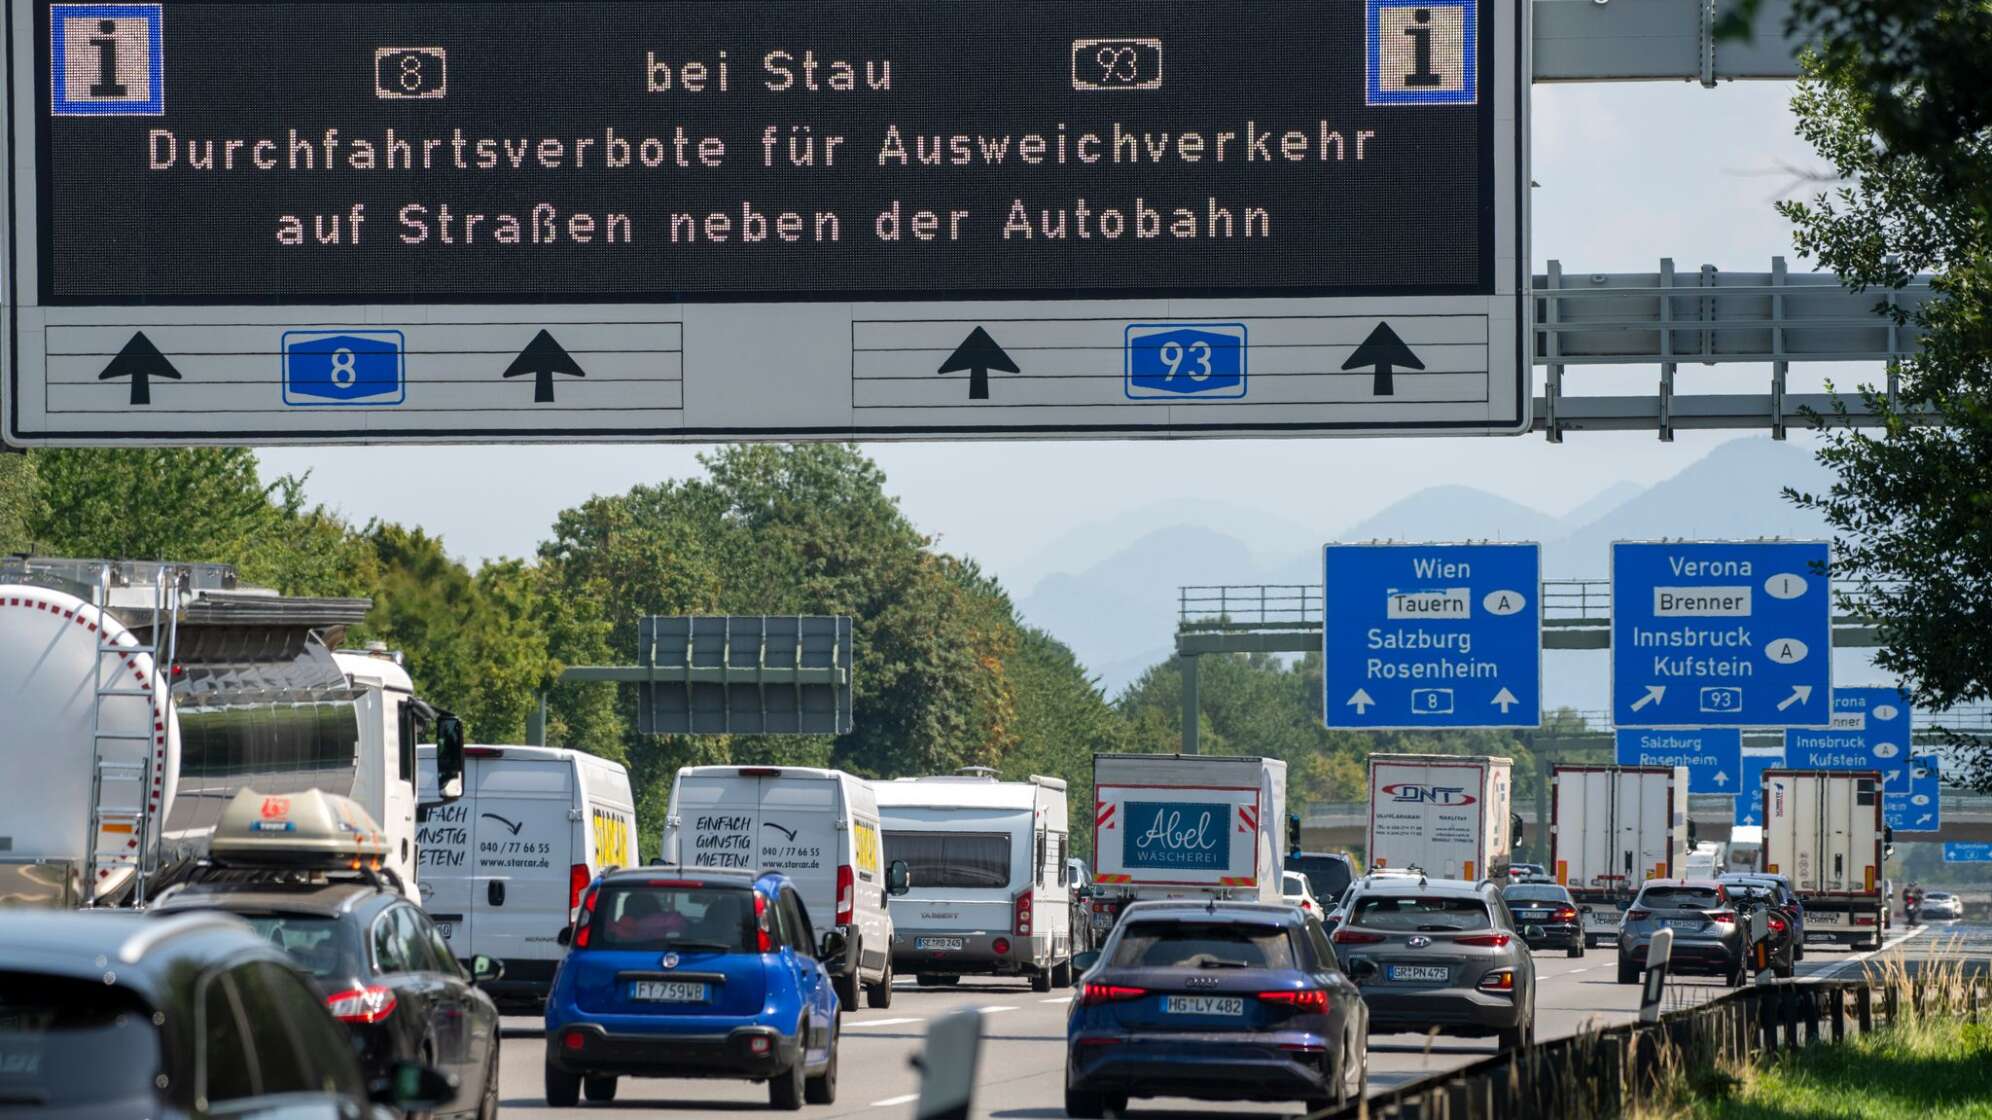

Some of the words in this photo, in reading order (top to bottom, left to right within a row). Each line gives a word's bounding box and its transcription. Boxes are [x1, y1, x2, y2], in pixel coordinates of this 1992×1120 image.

[400, 54, 421, 90] 8
[647, 52, 728, 93] bei
[763, 50, 892, 91] Stau
[1097, 46, 1138, 83] 93
[148, 128, 726, 170] Durchfahrtsverbote
[762, 125, 844, 167] für
[878, 121, 1376, 165] Ausweichverkehr
[276, 203, 364, 245] auf
[398, 202, 633, 245] Straßen
[670, 201, 840, 244] neben
[875, 199, 969, 241] der
[1003, 197, 1271, 240] Autobahn
[330, 348, 356, 389] 8
[1159, 341, 1213, 383] 93
[1413, 558, 1470, 579] Wien
[1669, 556, 1752, 576] Verona
[1394, 595, 1463, 612] Tauern
[1497, 596, 1511, 610] A
[1660, 593, 1744, 610] Brenner
[1367, 628, 1471, 653] Salzburg
[1633, 626, 1752, 647] Innsbruck
[1780, 643, 1793, 658] A
[1367, 658, 1498, 679] Rosenheim
[1654, 656, 1752, 676] Kufstein
[1428, 693, 1438, 708] 8
[1711, 692, 1731, 707] 93
[1834, 696, 1866, 707] rona
[1833, 717, 1861, 727] nner
[1640, 735, 1702, 751] Salzburg
[1796, 735, 1866, 748] Innsbruck
[1640, 753, 1717, 767] Rosenheim
[1809, 753, 1867, 767] Kufstein
[1136, 808, 1217, 849] Abel
[480, 841, 499, 853] 040
[508, 842, 521, 853] 77
[523, 842, 535, 853] 66
[538, 842, 550, 853] 55
[762, 847, 777, 857] 040
[785, 847, 795, 857] 77
[418, 851, 465, 867] ETEN!
[480, 857, 549, 869] www.starcar.de
[762, 859, 820, 869] www.starcar.de
[1168, 995, 1187, 1012] HG
[1195, 996, 1213, 1013] LY
[1217, 997, 1241, 1014] 482
